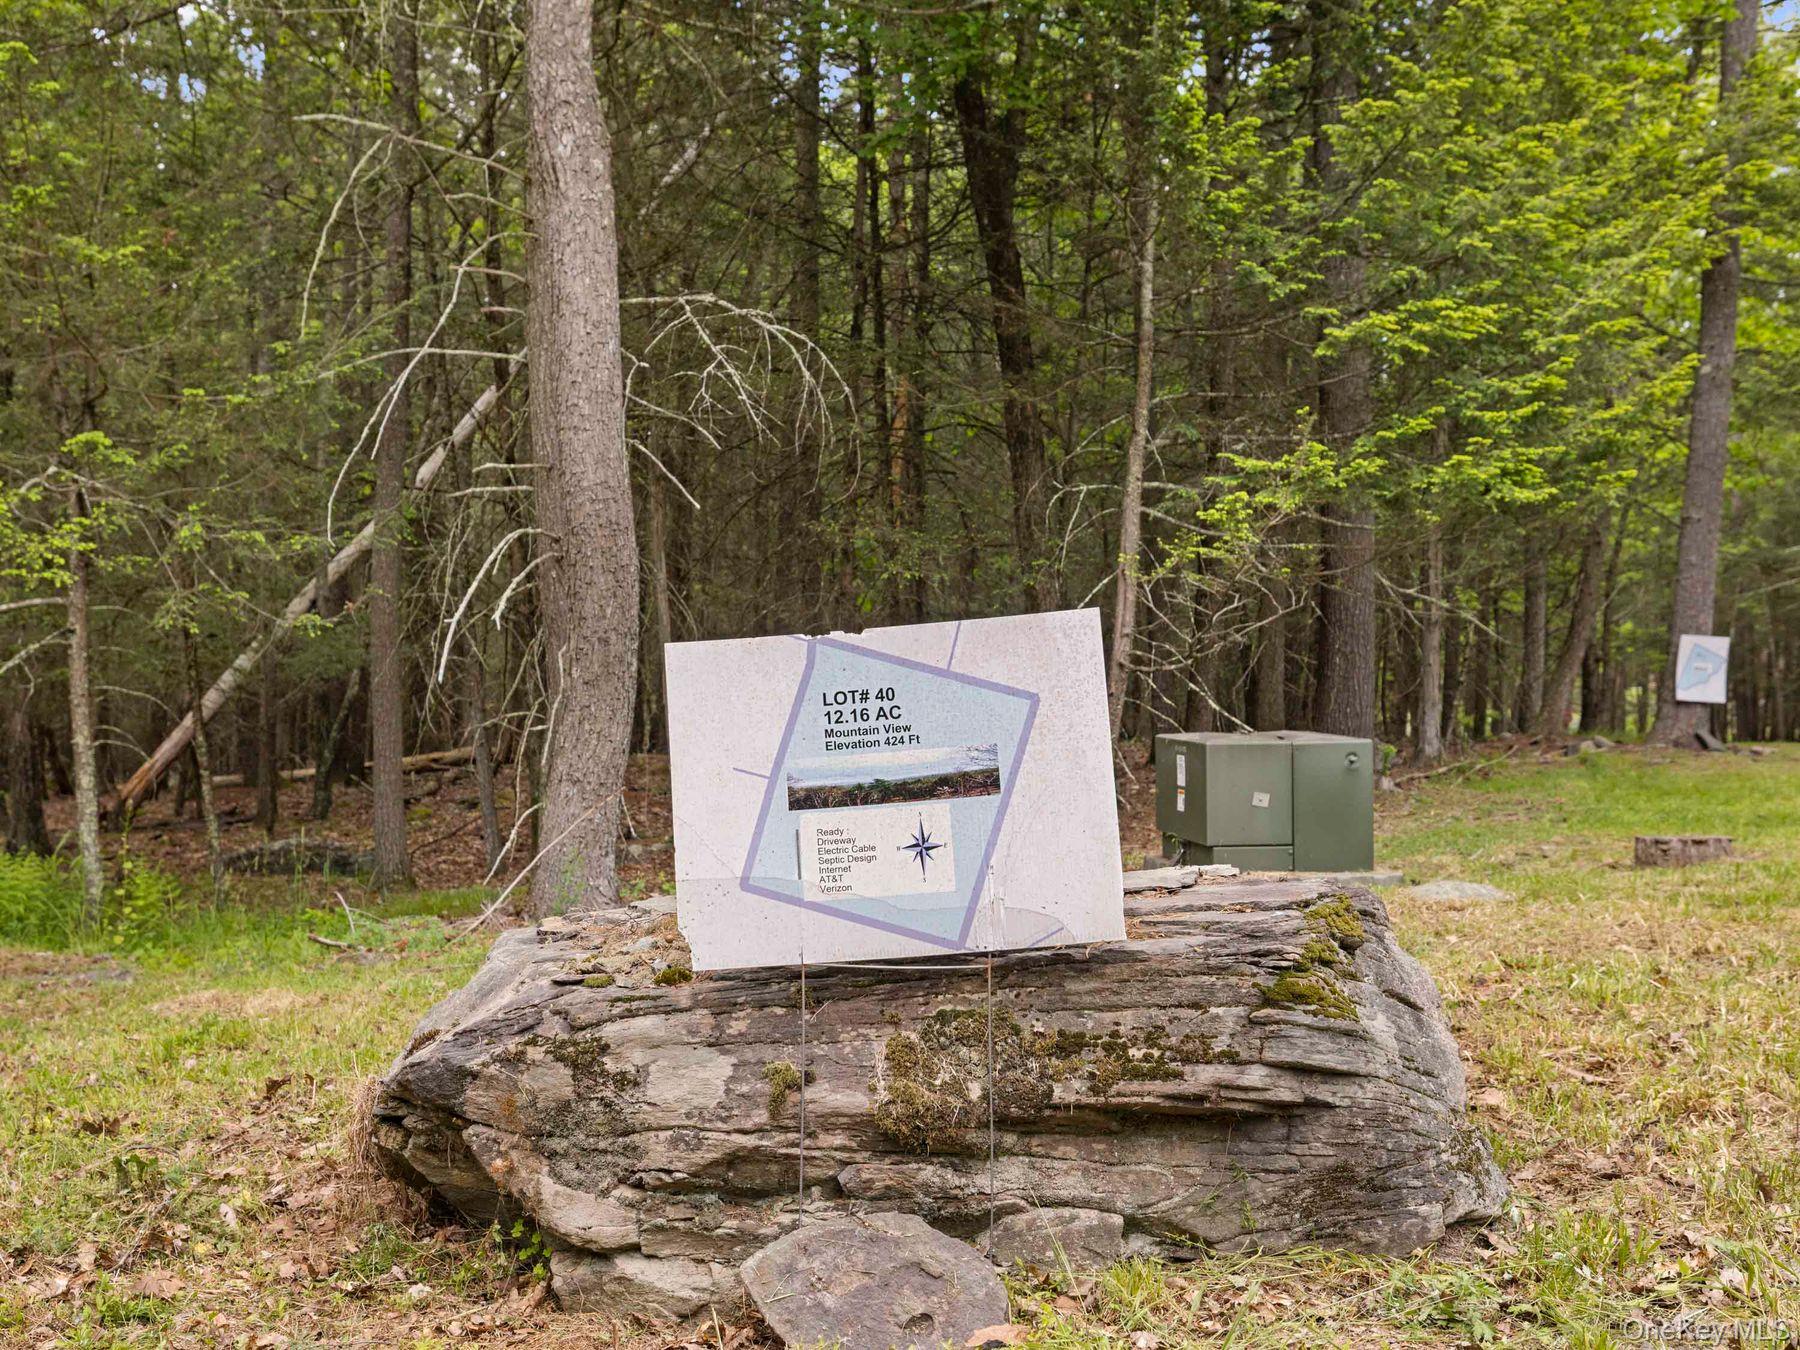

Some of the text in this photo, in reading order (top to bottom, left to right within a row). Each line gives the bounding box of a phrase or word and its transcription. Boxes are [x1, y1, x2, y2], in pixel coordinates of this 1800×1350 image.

[823, 687, 895, 706] LOT# 40
[824, 705, 902, 724] 12.16 AC
[824, 724, 912, 739] Mountain View
[825, 734, 920, 751] Elevation 424 Ft
[817, 837, 857, 846] Driveway
[818, 844, 876, 855] Electric Cable
[818, 854, 877, 866] Septic Design
[818, 865, 851, 874] Internet
[819, 874, 844, 883] AT&T
[820, 884, 852, 894] Verizon
